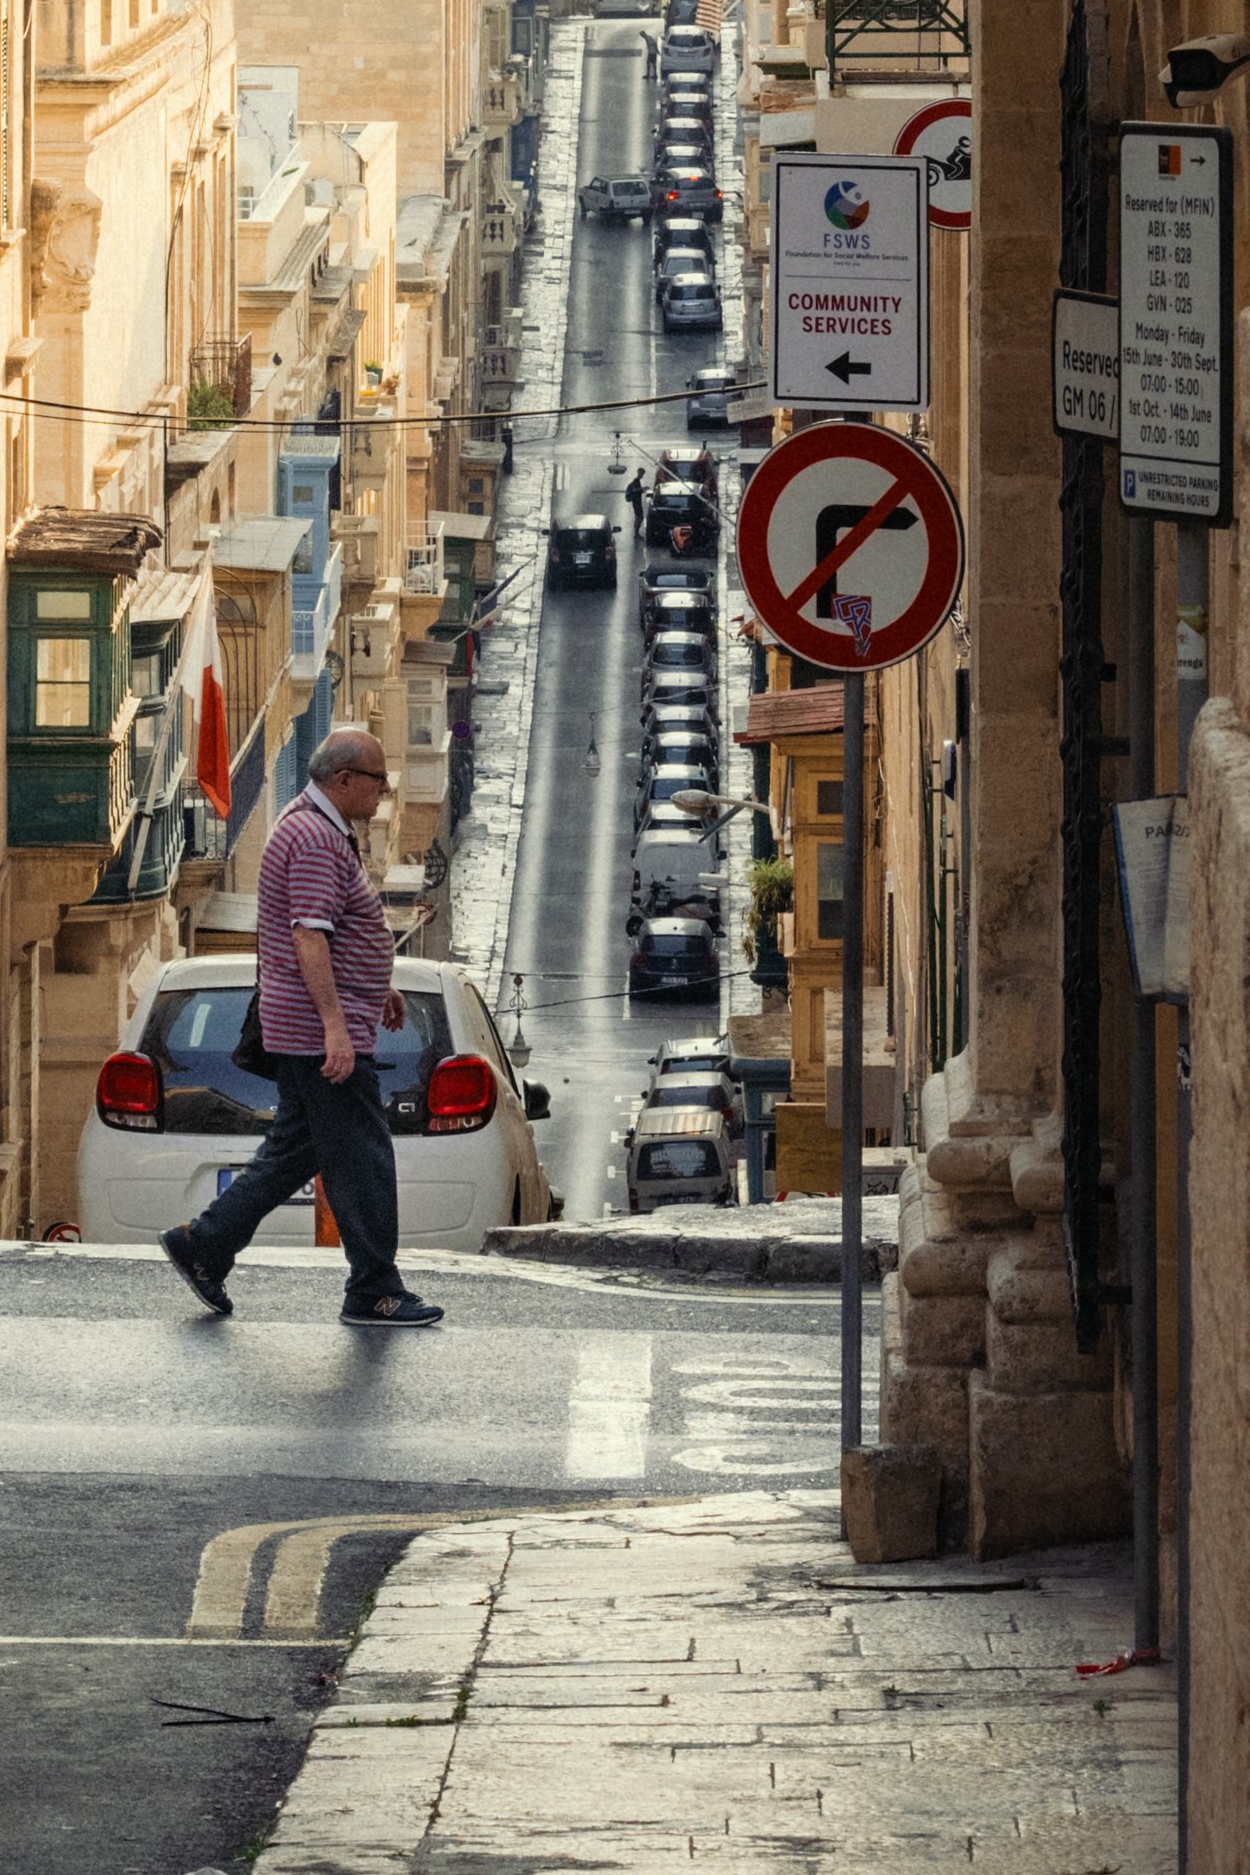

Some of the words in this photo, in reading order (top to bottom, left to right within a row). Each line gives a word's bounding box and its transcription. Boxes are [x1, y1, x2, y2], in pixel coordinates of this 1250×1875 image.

[1125, 194, 1163, 213] Reserved
[1166, 197, 1178, 213] for
[1181, 195, 1215, 217] (MFIN)
[1148, 220, 1166, 238] ABX
[1174, 222, 1191, 239] 365
[824, 233, 870, 250] FSWS
[785, 250, 823, 258] Foundation
[824, 251, 833, 259] for
[834, 252, 855, 260] Social
[856, 253, 880, 261] Welfare
[882, 254, 909, 262] Services
[1148, 244, 1166, 262] HBX
[1175, 247, 1192, 264] 628
[1150, 270, 1166, 287] LEA
[1174, 272, 1190, 289] 120
[788, 293, 902, 313] COMMUNITY
[1147, 294, 1167, 312] GVN
[1175, 297, 1192, 314] 025
[802, 316, 892, 336] SERVICES
[1136, 322, 1169, 346] Monday
[1178, 326, 1205, 349] Friday
[1123, 347, 1140, 364] 15th
[1143, 350, 1163, 367] June
[1171, 351, 1192, 370] 30th
[1195, 353, 1219, 374] Sept.
[1141, 374, 1166, 393] 07:00
[1175, 377, 1199, 396] 15:00
[1063, 384, 1084, 418] GM
[1089, 390, 1106, 422] 06
[1129, 398, 1141, 416] 1st
[1143, 399, 1161, 418] Oct.
[1170, 403, 1189, 421] 14th
[1191, 404, 1212, 424] June
[1141, 425, 1166, 444] 07:00
[1174, 428, 1199, 448] 19:00
[1138, 471, 1187, 488] UNRESTRICTED
[1189, 476, 1219, 493] PARKING
[1147, 488, 1186, 506] REMAINING
[1186, 492, 1210, 508] HOURS
